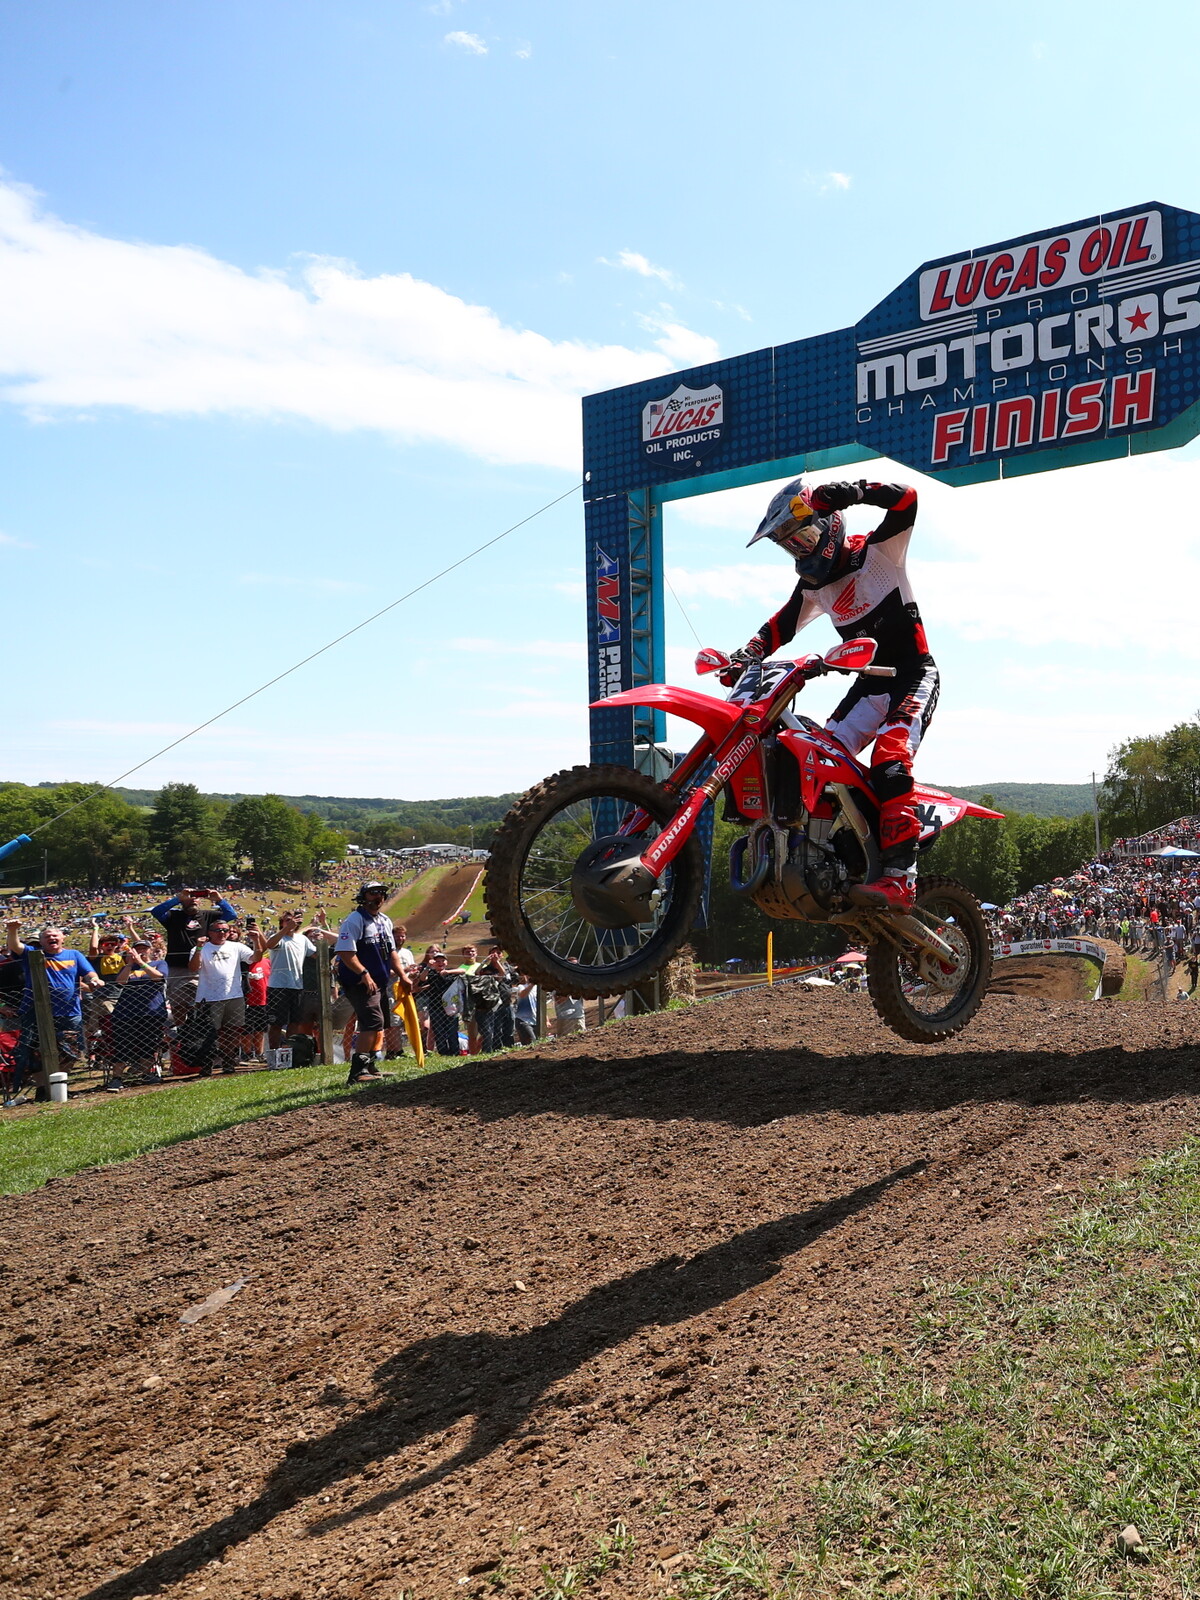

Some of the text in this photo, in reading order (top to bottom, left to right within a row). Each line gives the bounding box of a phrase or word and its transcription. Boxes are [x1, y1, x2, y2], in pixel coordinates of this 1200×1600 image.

[928, 215, 1153, 316] LUCAS OIL
[986, 286, 1089, 326] PRO
[650, 402, 721, 438] LUCAS
[684, 394, 721, 408] PERFORMANCE
[930, 367, 1157, 465] FINISH
[646, 428, 721, 454] OIL PRODUCTS
[673, 449, 694, 462] INC.
[595, 541, 621, 645] AMA
[837, 602, 872, 622] HONDA
[606, 645, 622, 698] PRO
[718, 733, 755, 782] SHOWA
[651, 806, 693, 863] DUNLOP
